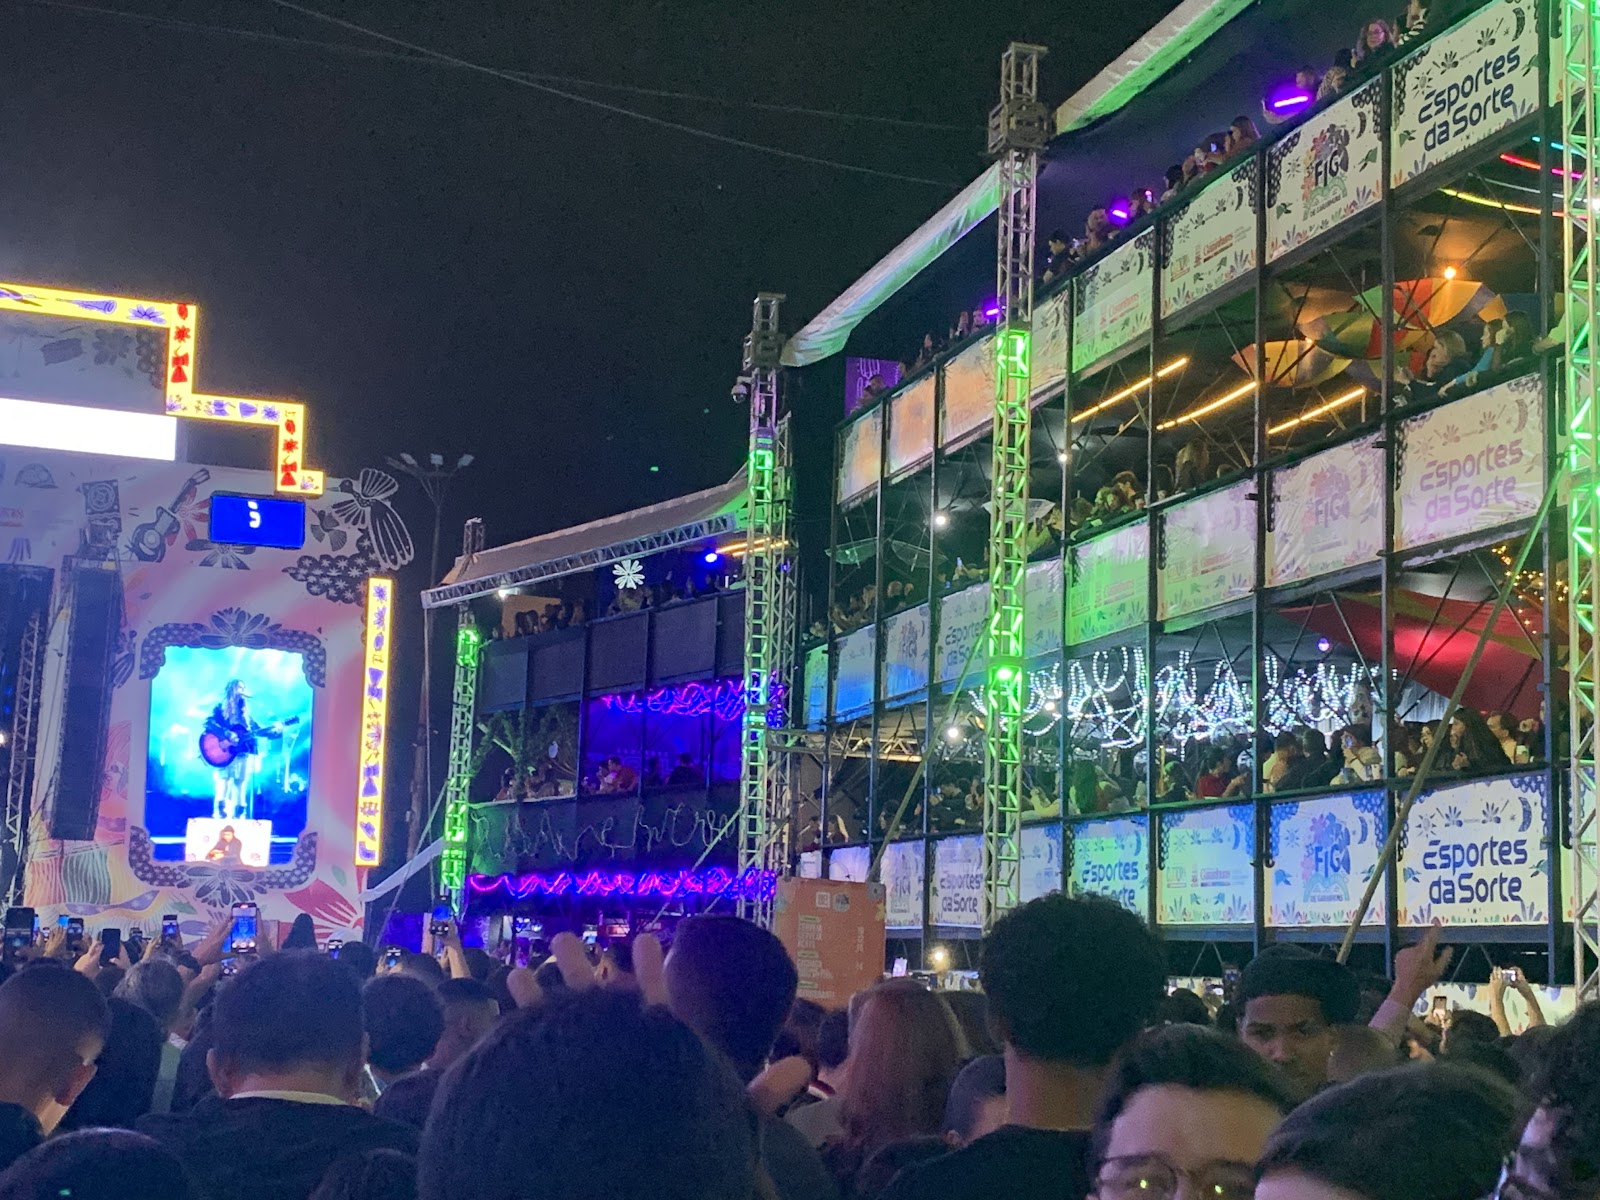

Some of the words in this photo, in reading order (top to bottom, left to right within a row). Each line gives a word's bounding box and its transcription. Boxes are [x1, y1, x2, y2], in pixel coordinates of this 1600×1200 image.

[1418, 45, 1520, 124] Esportes
[1315, 150, 1339, 187] FIG
[1420, 439, 1523, 491] Esportes
[1082, 859, 1139, 887] Esportes
[1314, 843, 1341, 878] FIG
[1422, 836, 1528, 875] Esportes
[941, 871, 982, 893] Esportes
